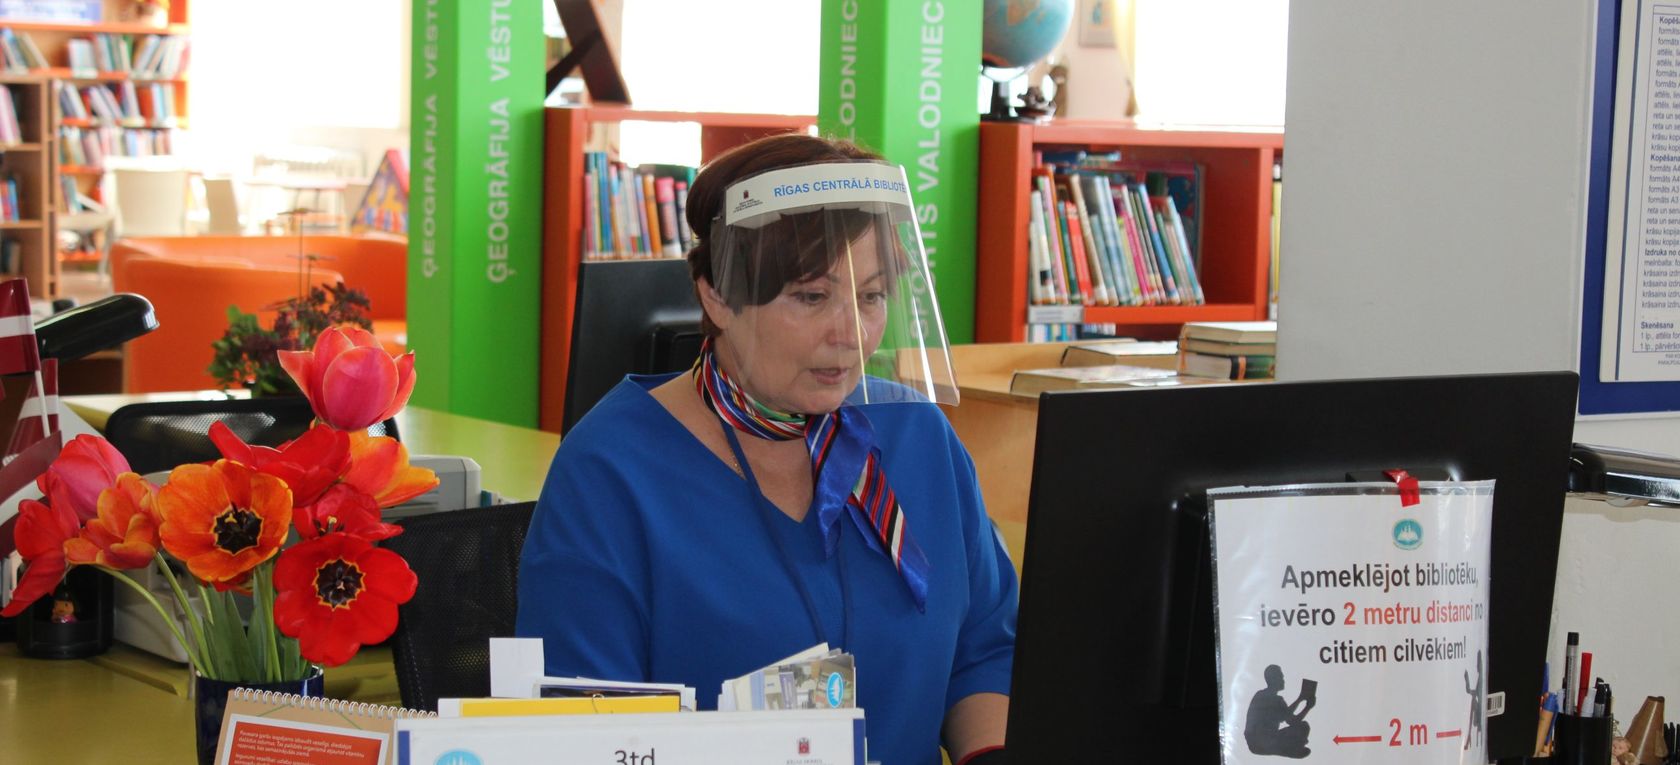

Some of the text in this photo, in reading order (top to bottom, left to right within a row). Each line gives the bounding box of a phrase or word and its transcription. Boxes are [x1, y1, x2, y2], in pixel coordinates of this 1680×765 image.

[916, 0, 944, 192] VALODNIEC
[485, 98, 517, 283] ĢEOGRĀFIJA
[774, 183, 810, 198] RĪGAS
[813, 177, 872, 191] CENTRĀLĀ
[1645, 248, 1667, 256] Izdruka
[1281, 562, 1479, 594] Apmeklējot bibliotēku,
[1260, 603, 1336, 628] ievēro
[1343, 602, 1357, 626] 2
[1364, 601, 1421, 625] metru
[1426, 599, 1473, 624] distanci
[1319, 636, 1467, 664] citiem cilvēkiem!
[1389, 718, 1428, 747] 2 m
[614, 747, 655, 765] 3td
